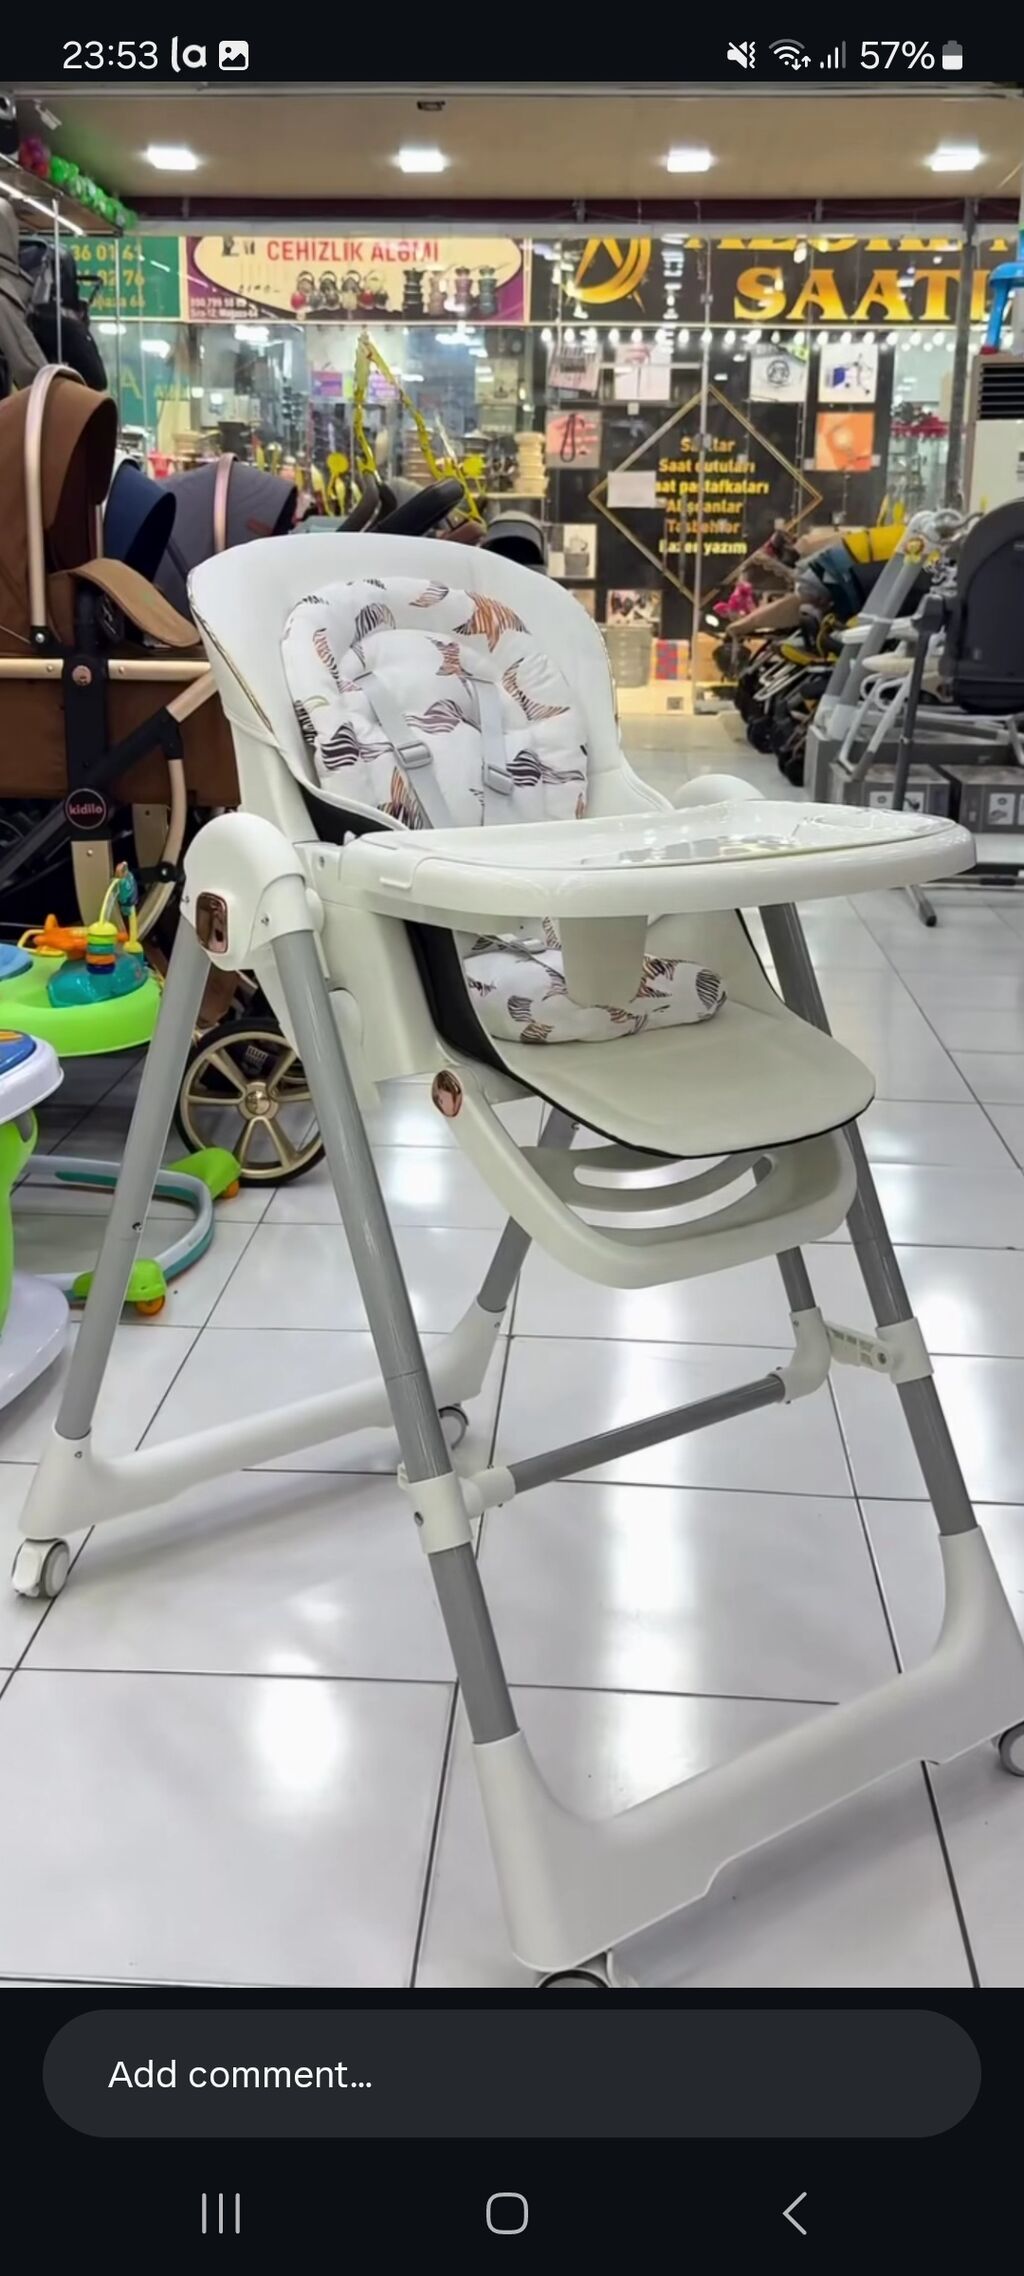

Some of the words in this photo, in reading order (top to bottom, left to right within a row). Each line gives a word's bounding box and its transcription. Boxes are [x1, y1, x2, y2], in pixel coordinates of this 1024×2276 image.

[659, 458, 692, 473] Saat
[656, 480, 676, 493] aat
[703, 542, 747, 556] yazım
